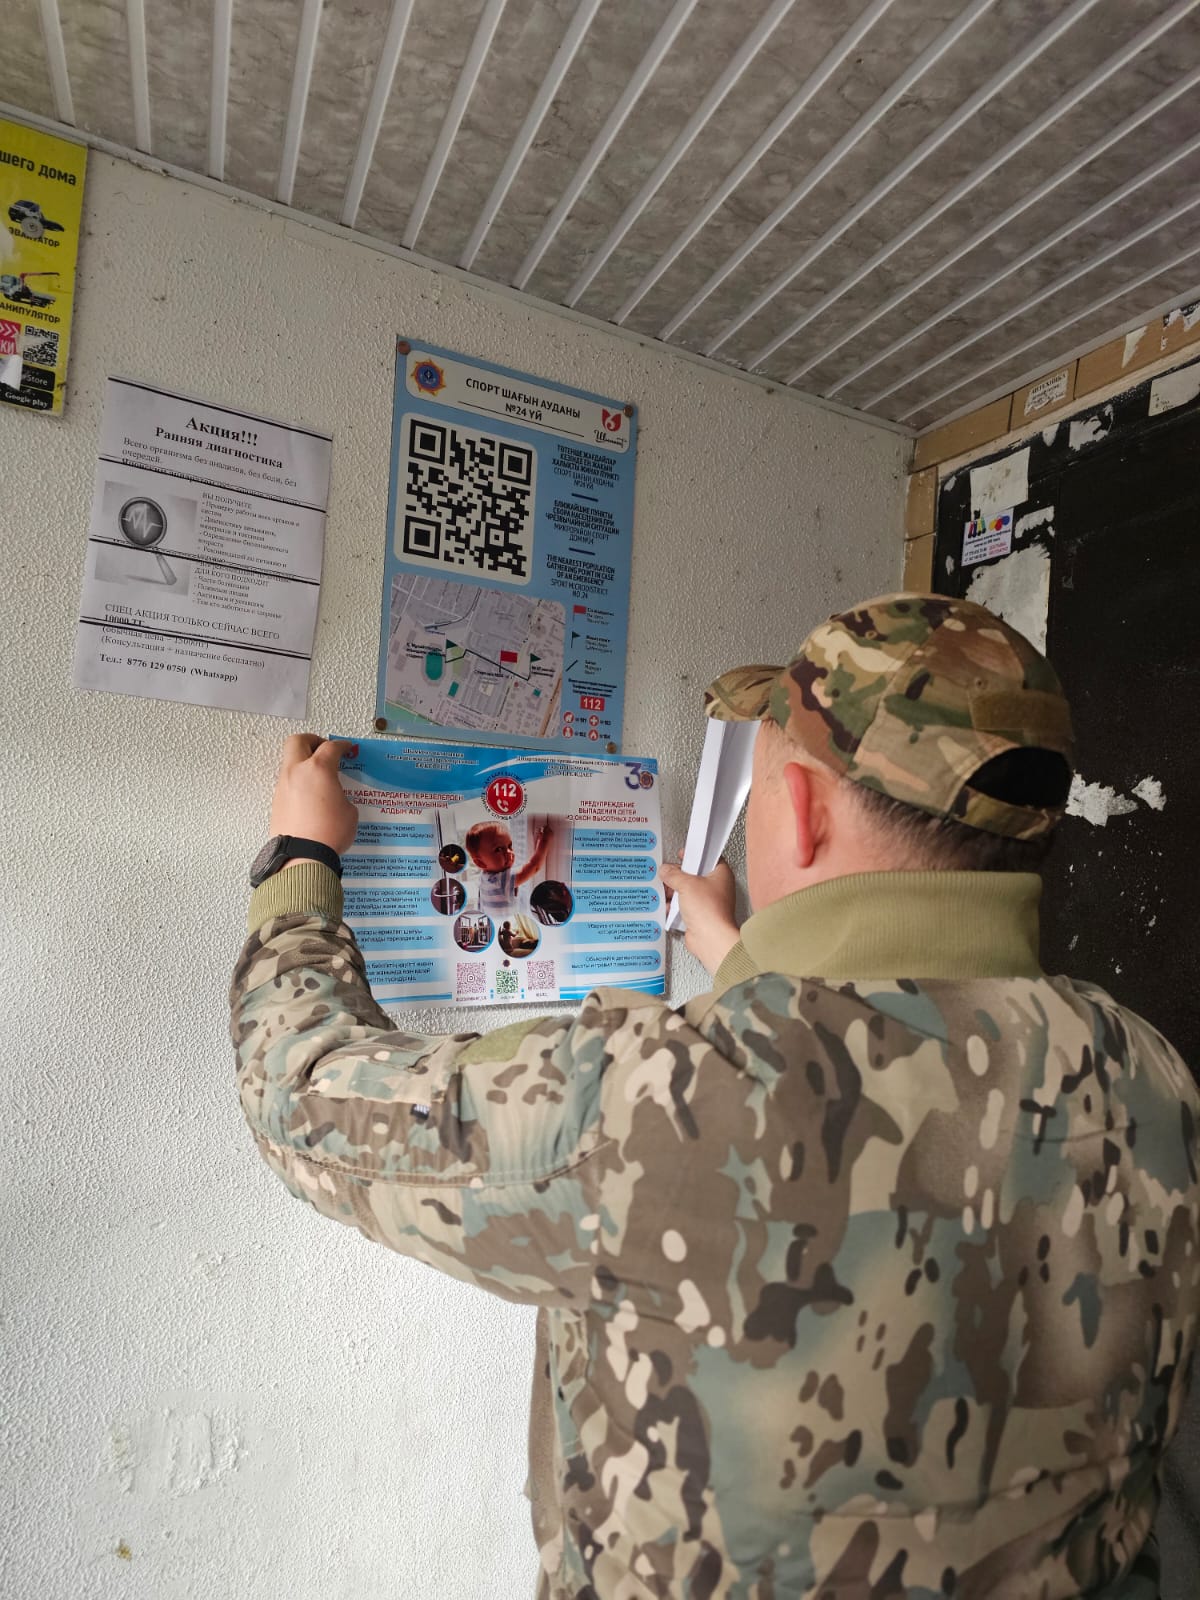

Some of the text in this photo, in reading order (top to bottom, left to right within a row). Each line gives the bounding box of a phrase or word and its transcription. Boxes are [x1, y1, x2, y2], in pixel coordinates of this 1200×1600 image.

[38, 164, 76, 186] дома
[8, 226, 60, 248] ЭВААТОР
[5, 391, 48, 408] Google play
[465, 377, 581, 419] СПОРТ ШАҒЫН АУДАНЫ
[505, 403, 542, 421] №24 ҮЙ
[185, 416, 258, 446] Акция!!!
[123, 437, 148, 450] Всего
[149, 444, 193, 462] организма
[194, 453, 208, 464] без
[155, 426, 282, 469] Ранняя диагностика
[546, 512, 620, 535] ЧРЕЗВЫЧАЙНОЙ СИТУАЦИИ
[571, 511, 602, 523] НАСЕЛЕНИЯ
[546, 562, 577, 574] GATHERING
[578, 567, 595, 577] POINT
[601, 573, 614, 581] CASE
[547, 554, 615, 574] THE NEAREST POPULATION
[573, 574, 605, 586] EMERGENCY
[105, 603, 280, 640] СПЕЦ АКЦИЯ ТОЛЬКО СЕЙЧАС ВСЕГО
[101, 635, 165, 653] (Консультация
[175, 647, 221, 662] назначение
[222, 654, 265, 669] бесплатно)
[99, 653, 238, 682] Тел.: 8776 129 0750 (Whatsapp)
[583, 698, 601, 710] 112
[493, 782, 517, 797] 112
[578, 807, 617, 815] ВЫПАДЕНИЯ
[580, 800, 636, 808] ПРЕДУПРЕЖДЕНИЕ
